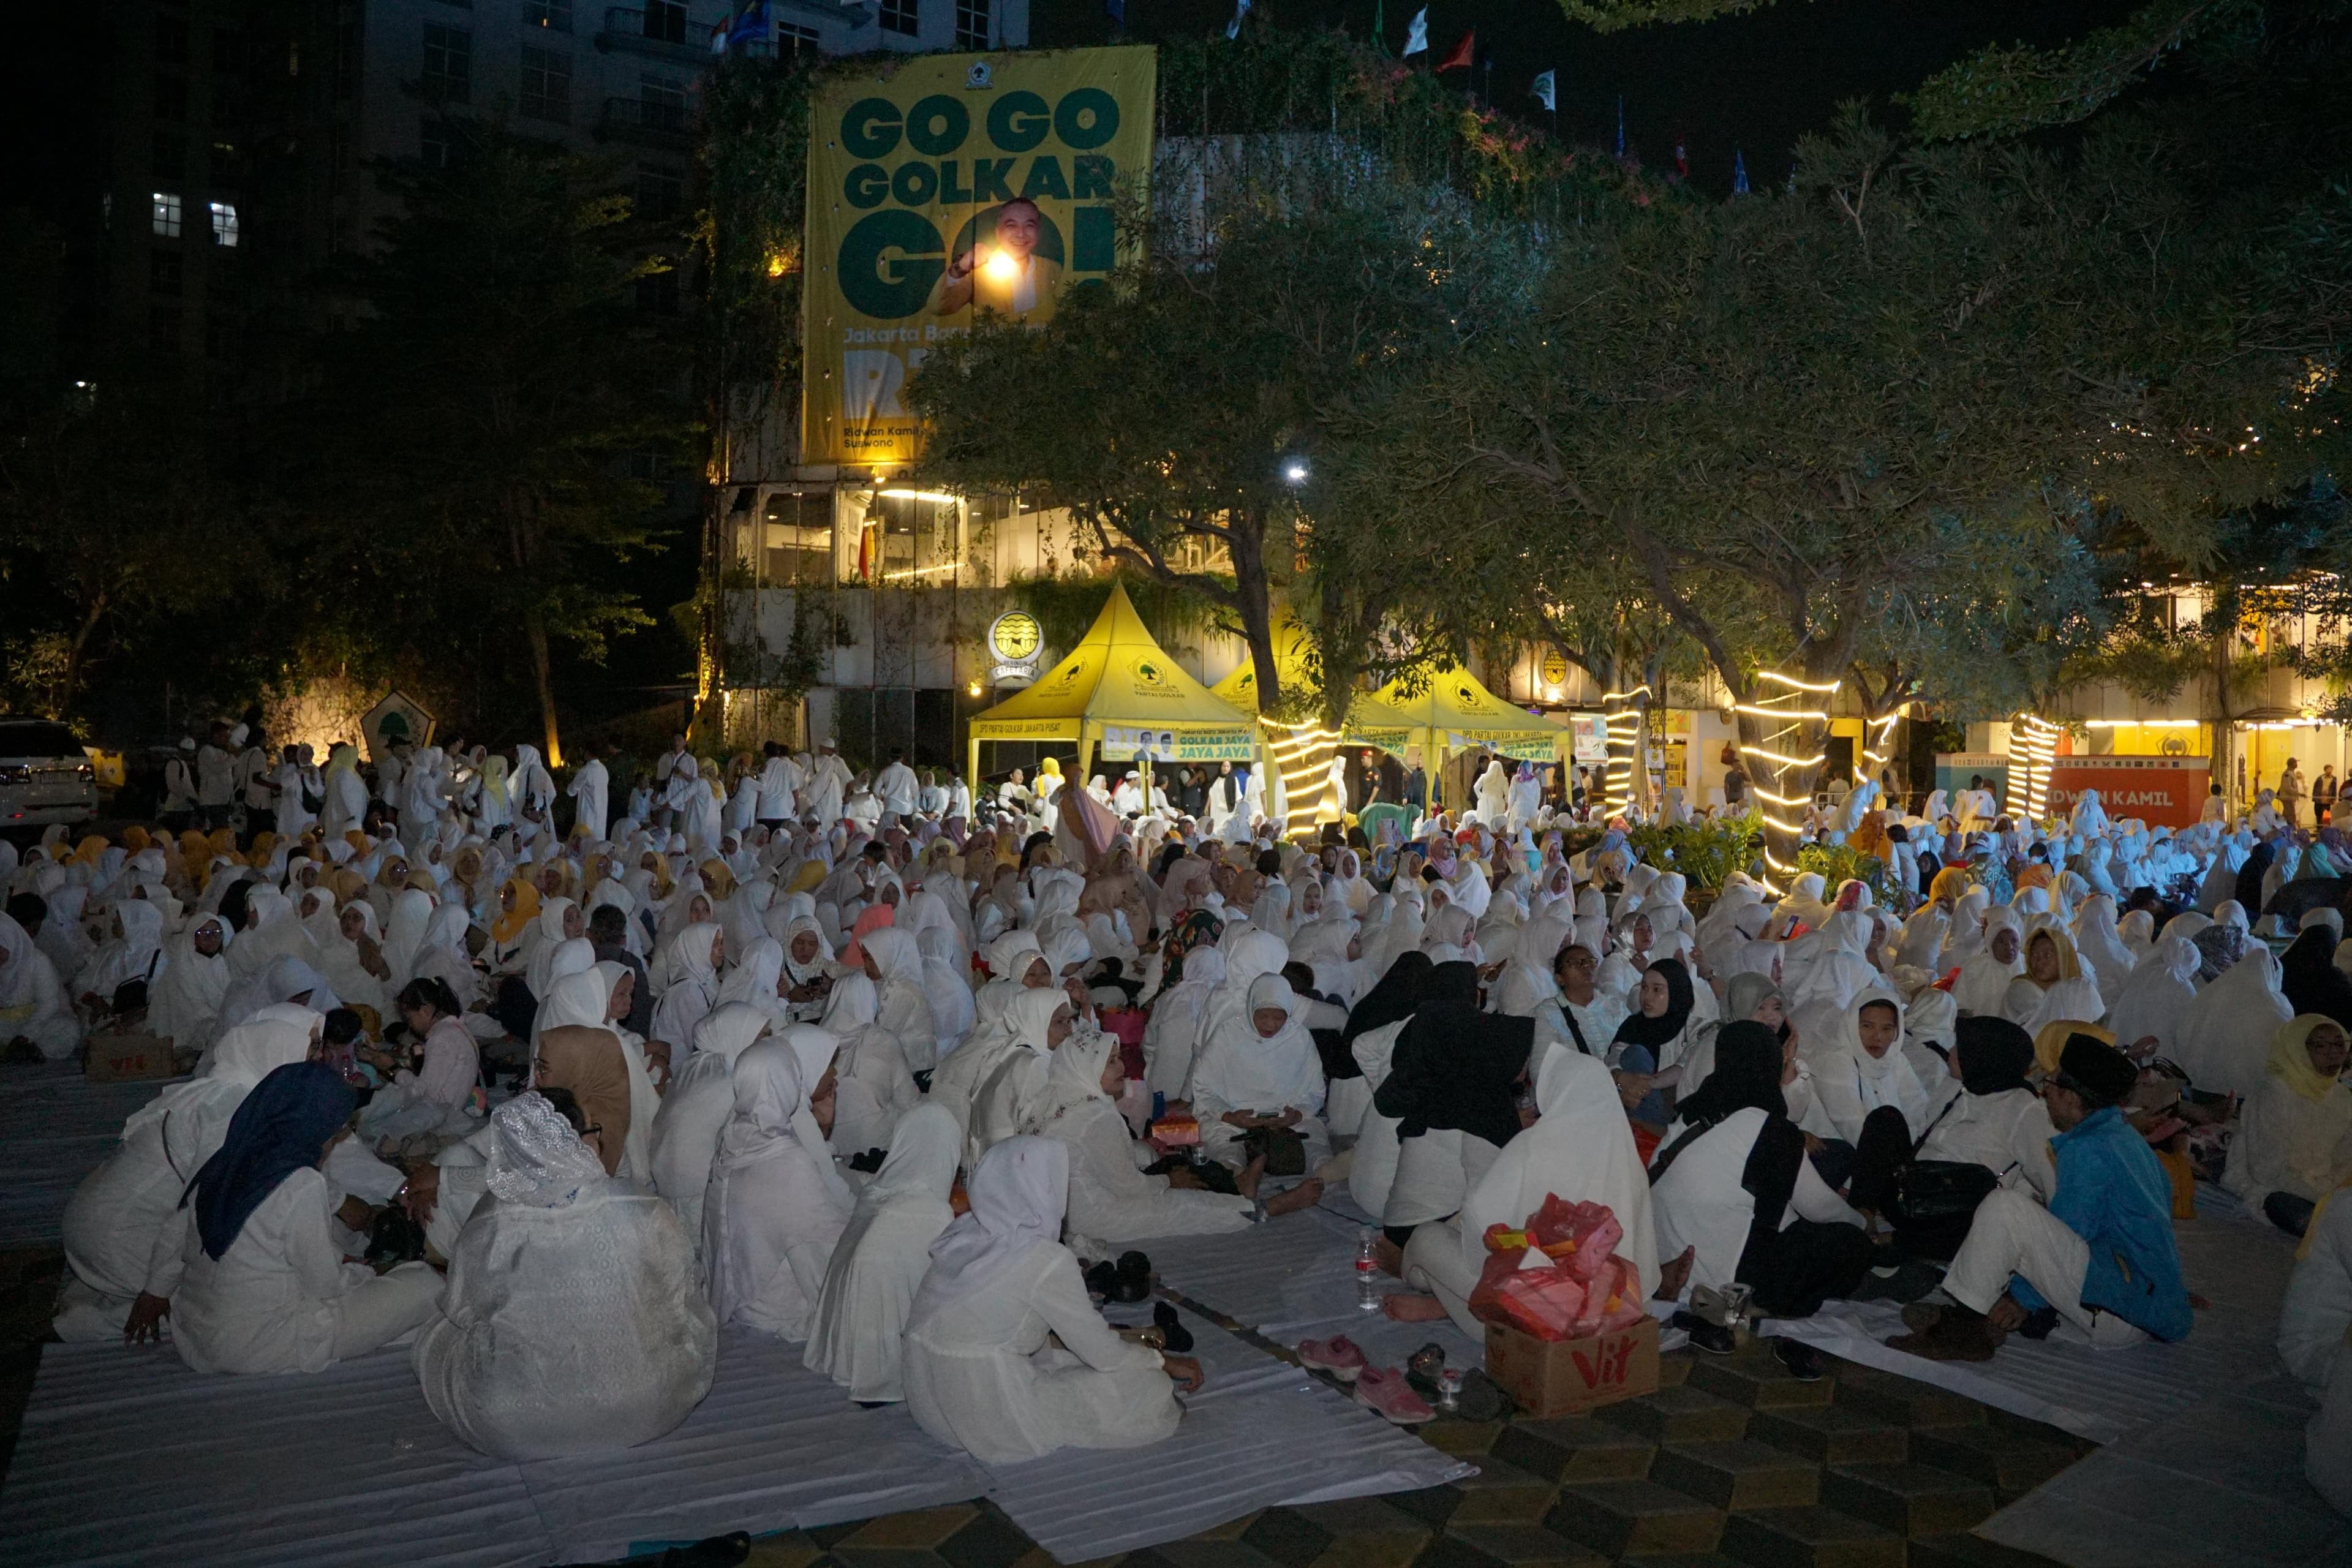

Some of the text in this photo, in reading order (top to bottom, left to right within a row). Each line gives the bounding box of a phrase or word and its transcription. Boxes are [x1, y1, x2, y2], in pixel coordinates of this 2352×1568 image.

[840, 88, 1120, 159] GO GO
[844, 156, 1115, 209] GOLKAR
[843, 326, 919, 344] Jakarta
[843, 426, 919, 437] Ridwan Kamil
[844, 439, 894, 448] Suswono
[995, 666, 1035, 677] CAFETARIA
[979, 723, 1061, 733] DPD PARTAI GOLKAR JAKARTA PUSAT
[1180, 736, 1250, 745] GOLKAR JAYA
[1474, 731, 1491, 739] PARTAI
[1180, 747, 1250, 758] JAYA JAYA
[2113, 790, 2174, 807] KAMIL
[1570, 1335, 1639, 1390] Vit
